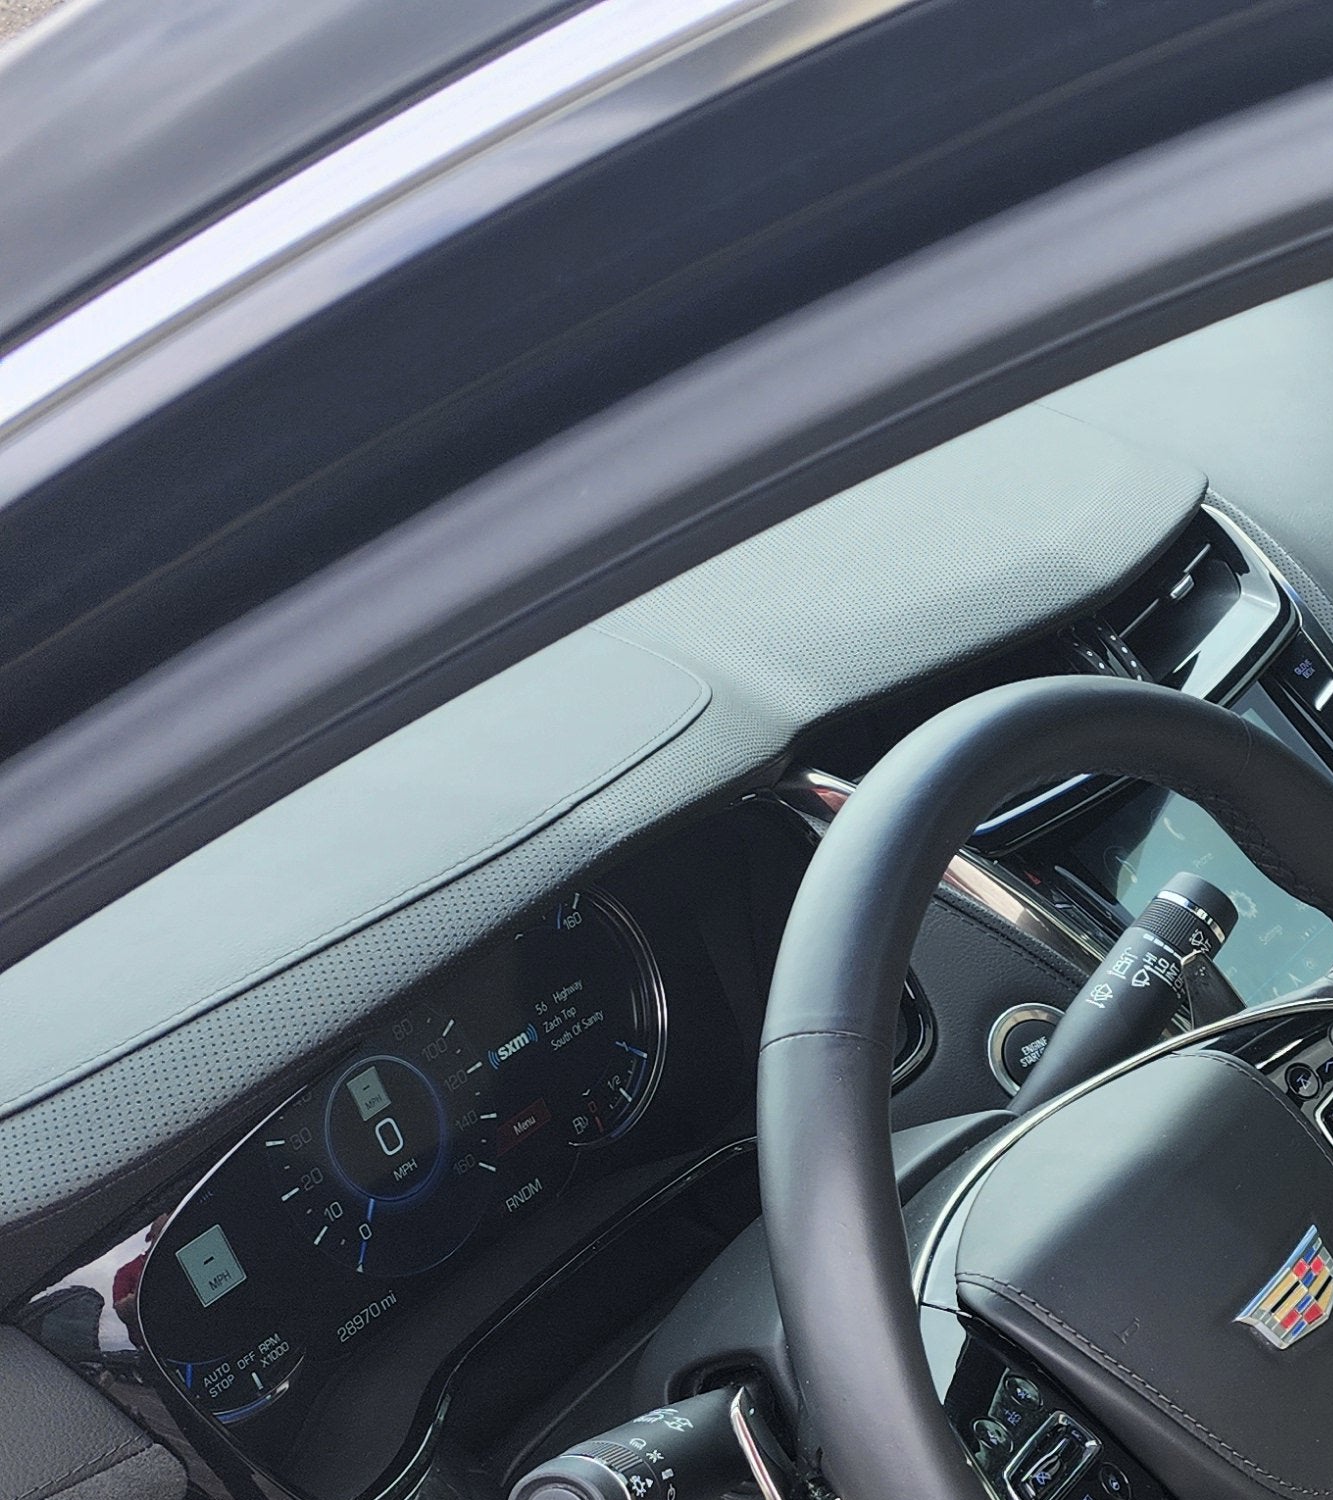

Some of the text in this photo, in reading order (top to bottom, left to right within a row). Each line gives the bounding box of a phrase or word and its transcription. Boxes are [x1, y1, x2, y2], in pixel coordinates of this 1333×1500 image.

[563, 911, 583, 930] 160
[1142, 952, 1158, 966] HI
[1154, 957, 1170, 974] LO
[1165, 962, 1180, 982] INT
[535, 979, 583, 1016] 56 Highway
[543, 1006, 577, 1033] Zach Top
[551, 1010, 604, 1051] South Of Sanity
[422, 1038, 448, 1061] 100
[497, 1031, 531, 1061] sxm
[1021, 1036, 1047, 1056] ENGINE
[444, 1070, 468, 1092] 120
[455, 1110, 478, 1131] 140
[513, 1116, 536, 1135] Menu
[375, 1117, 404, 1156] 0
[393, 1158, 418, 1181] MPH
[453, 1153, 476, 1175] 160
[301, 1167, 324, 1191] 20
[505, 1178, 543, 1213] RNDM
[324, 1201, 343, 1222] 10
[358, 1223, 372, 1240] 0
[208, 1270, 232, 1291] MPH
[337, 1289, 397, 1343] 28970 mi
[258, 1333, 281, 1354] RPM
[260, 1341, 290, 1368] X1000
[236, 1350, 256, 1370] OFF
[203, 1362, 231, 1388] AUTO
[208, 1374, 235, 1398] STOP
